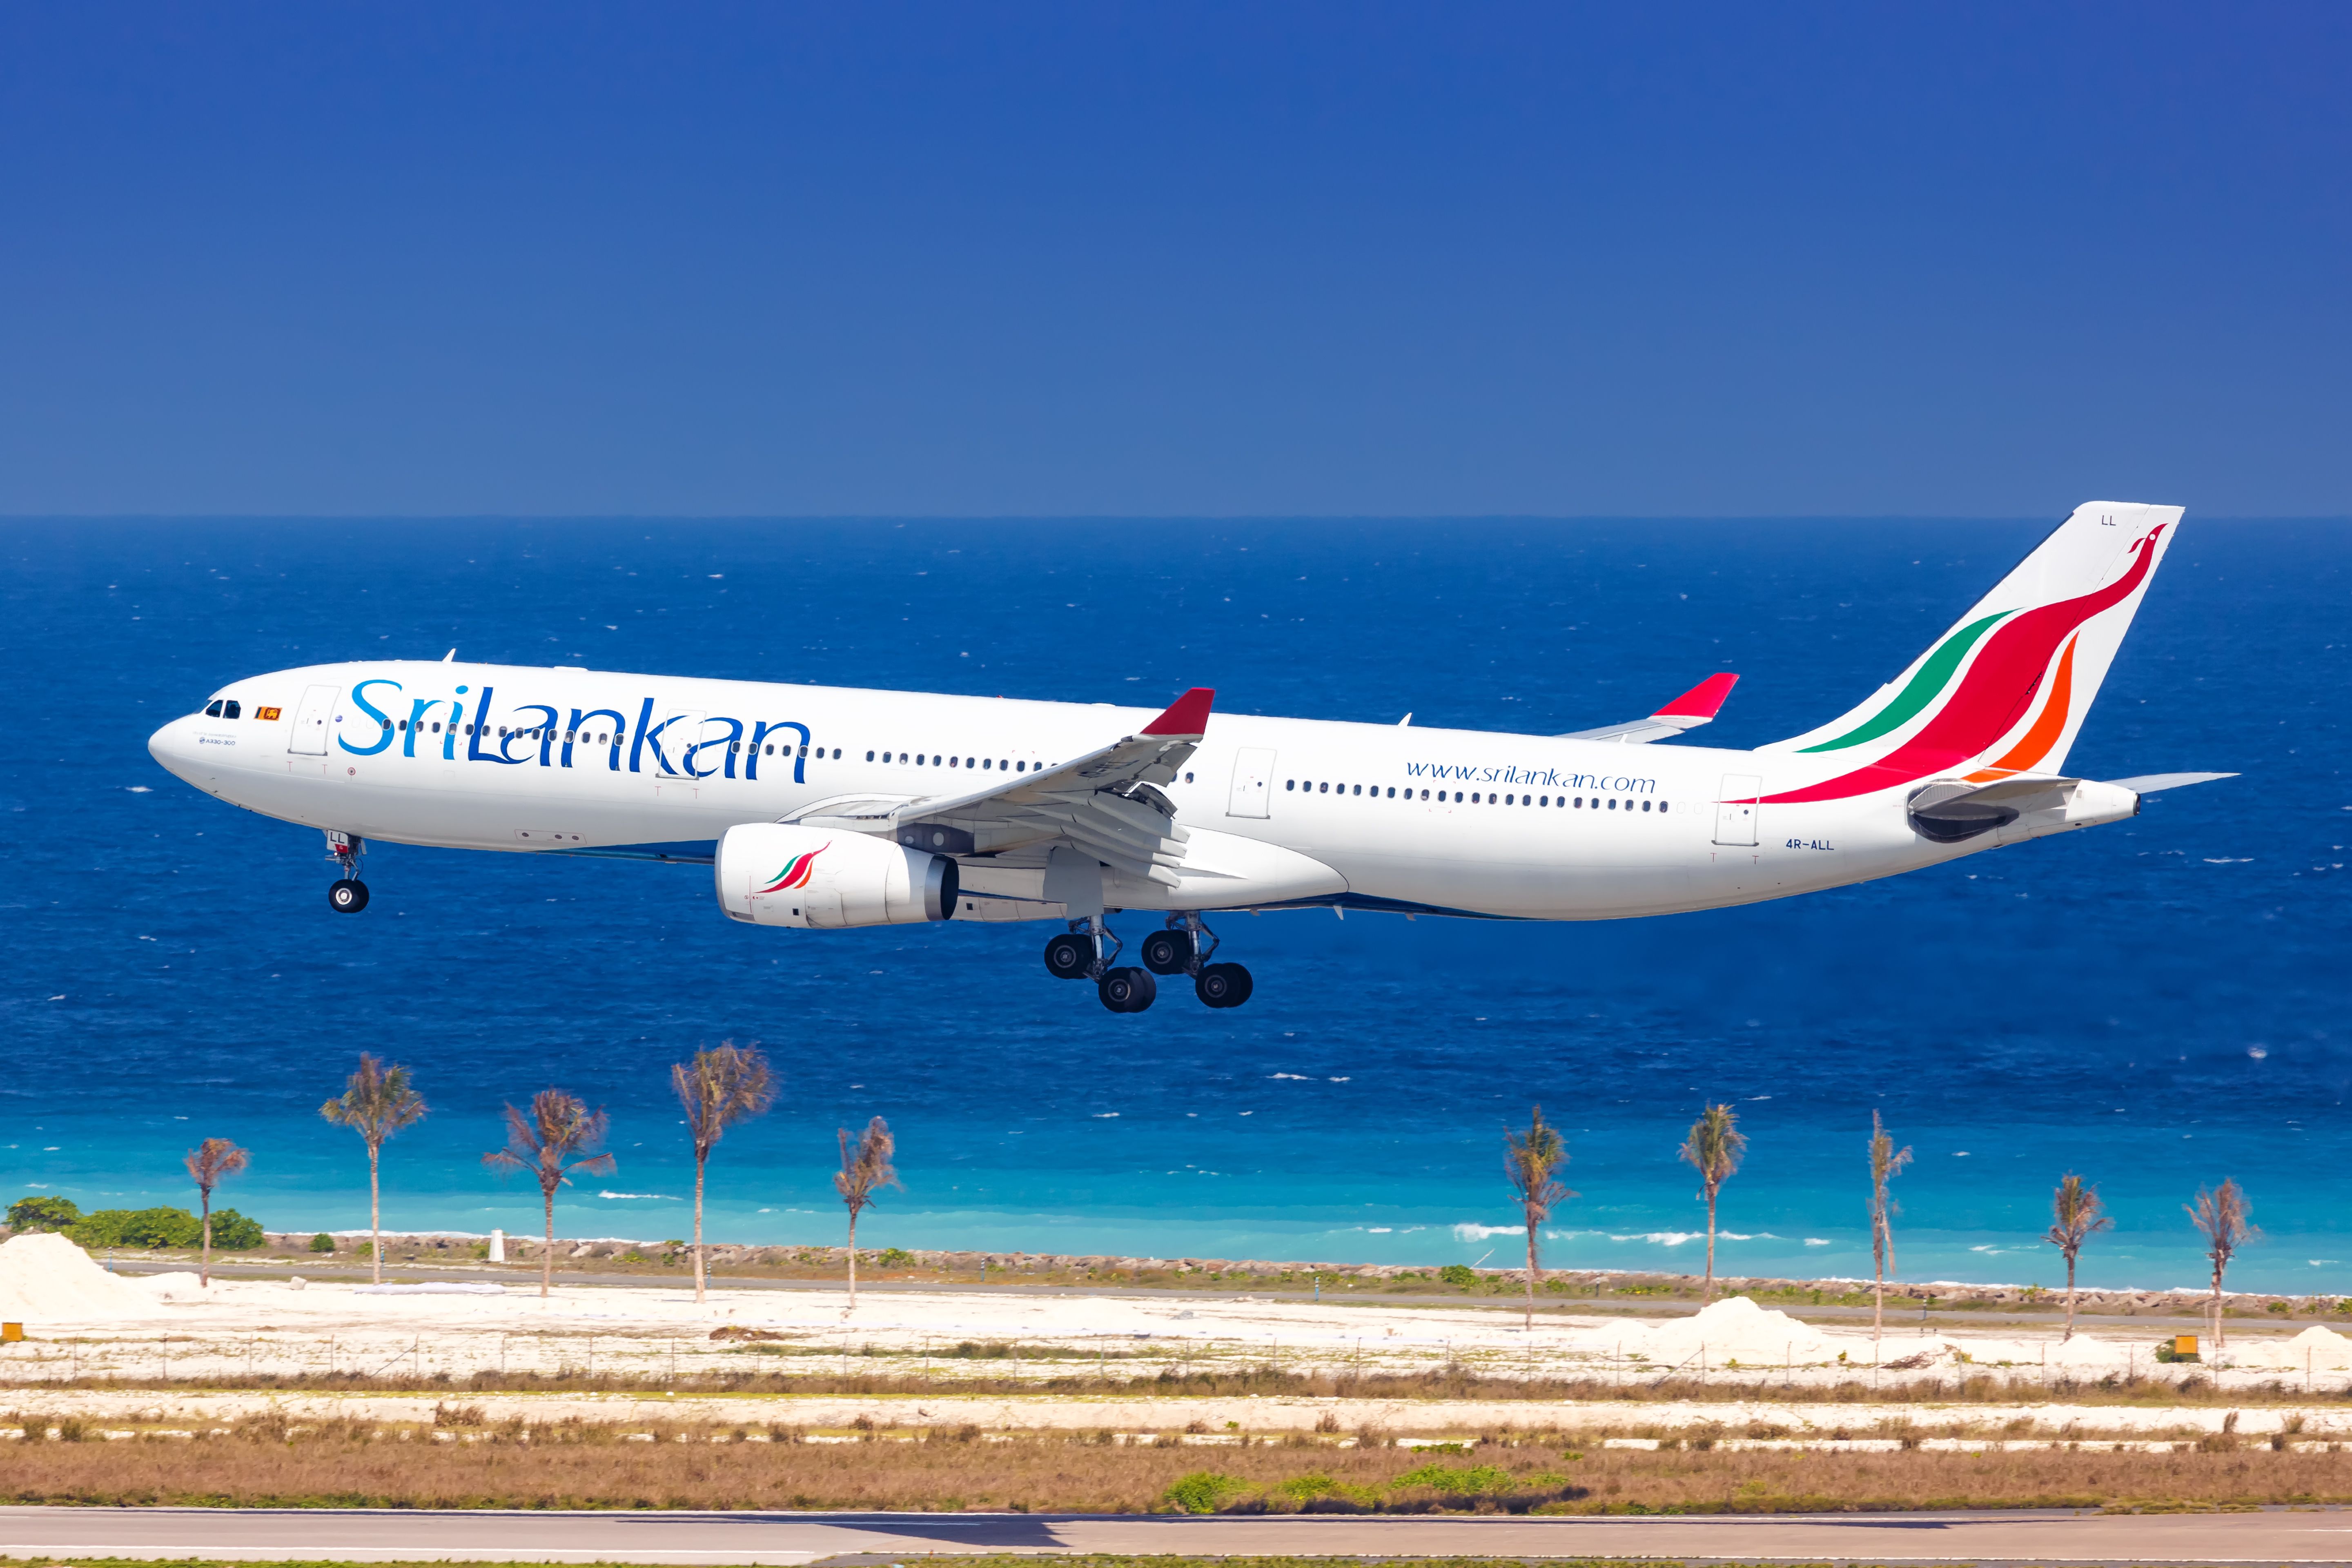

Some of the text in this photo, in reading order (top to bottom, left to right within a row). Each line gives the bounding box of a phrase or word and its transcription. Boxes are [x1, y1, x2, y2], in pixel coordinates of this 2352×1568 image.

[2102, 515, 2116, 526] LL
[338, 679, 811, 784] SriLankan
[1407, 762, 1655, 794] www.srilankan.com
[330, 832, 345, 844] LL
[1786, 839, 1835, 851] 4R-ALL
